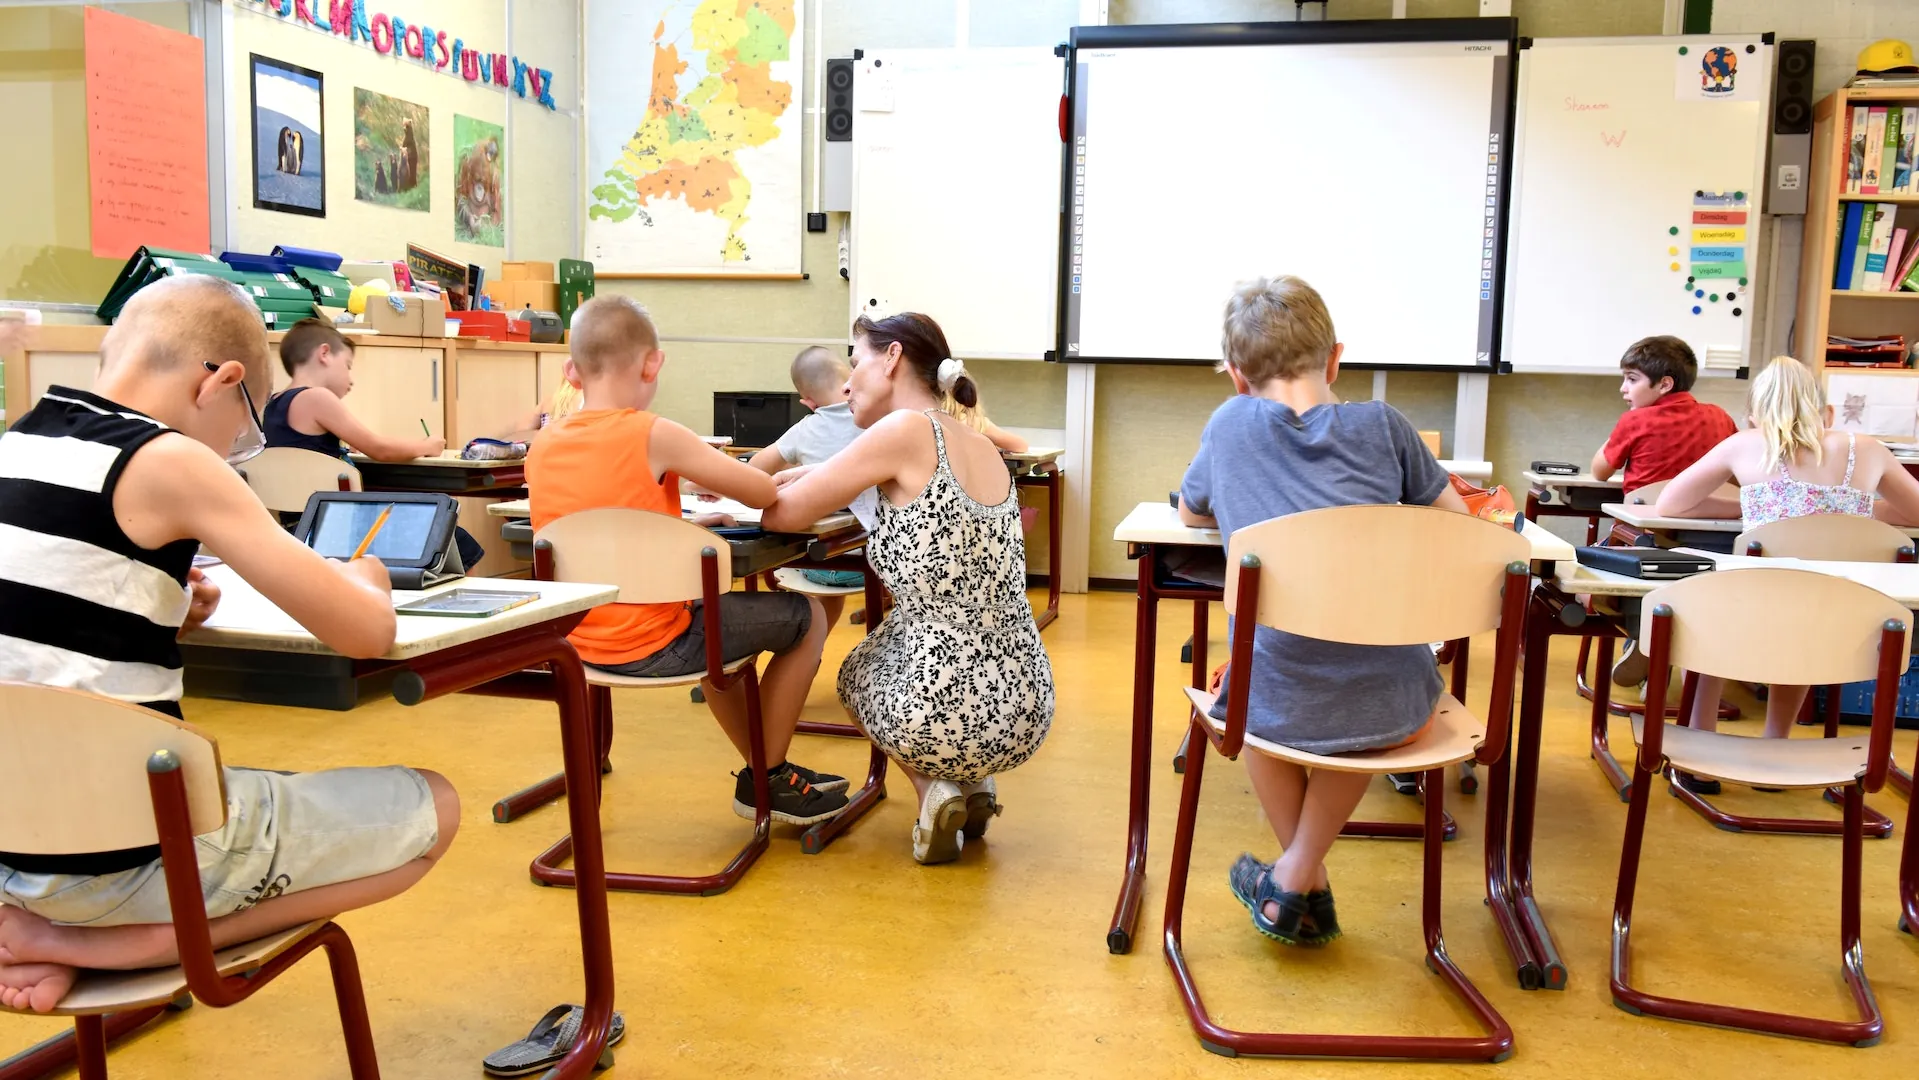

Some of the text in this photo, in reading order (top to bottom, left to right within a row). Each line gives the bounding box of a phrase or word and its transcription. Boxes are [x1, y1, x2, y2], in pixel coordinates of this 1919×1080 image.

[1600, 129, 1628, 148] W
[1699, 231, 1736, 239] Woensdag
[1698, 250, 1735, 258] Donderdag
